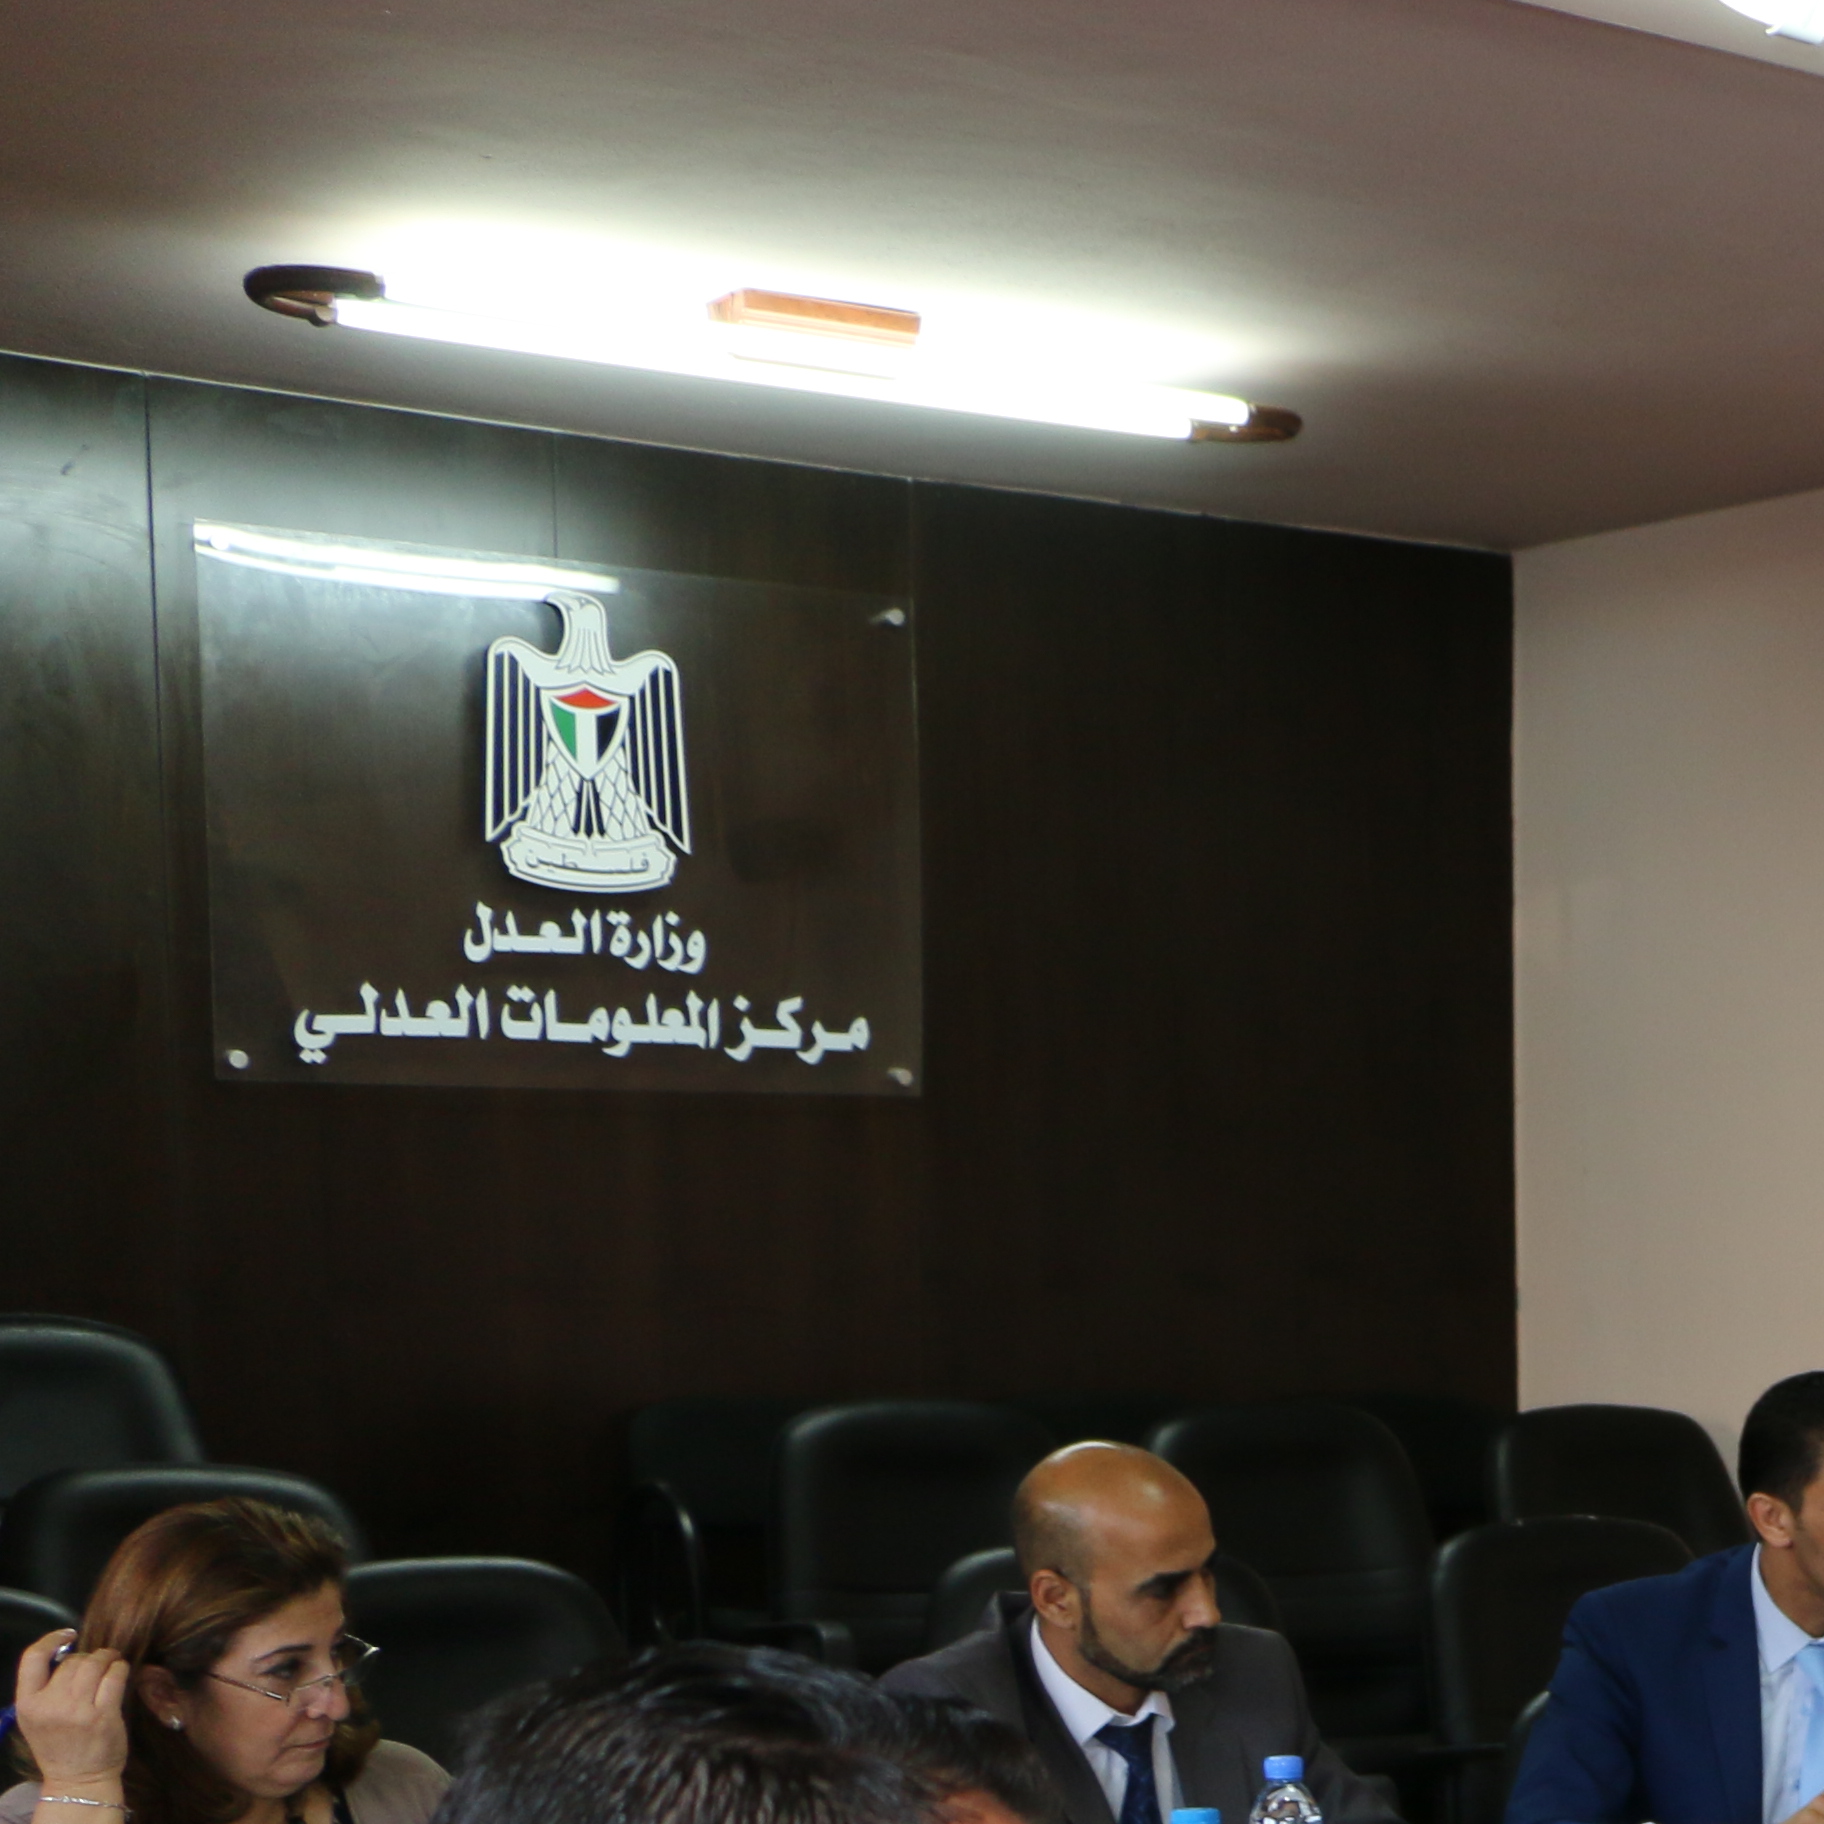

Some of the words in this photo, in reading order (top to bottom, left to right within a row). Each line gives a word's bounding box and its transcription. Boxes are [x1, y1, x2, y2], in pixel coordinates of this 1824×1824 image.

[525, 849, 650, 874] فلسطين
[462, 901, 602, 963] العدل
[607, 909, 707, 974] وزارة
[293, 981, 490, 1064] العدلي
[500, 986, 721, 1058] المعلومات
[722, 995, 871, 1065] مركز
